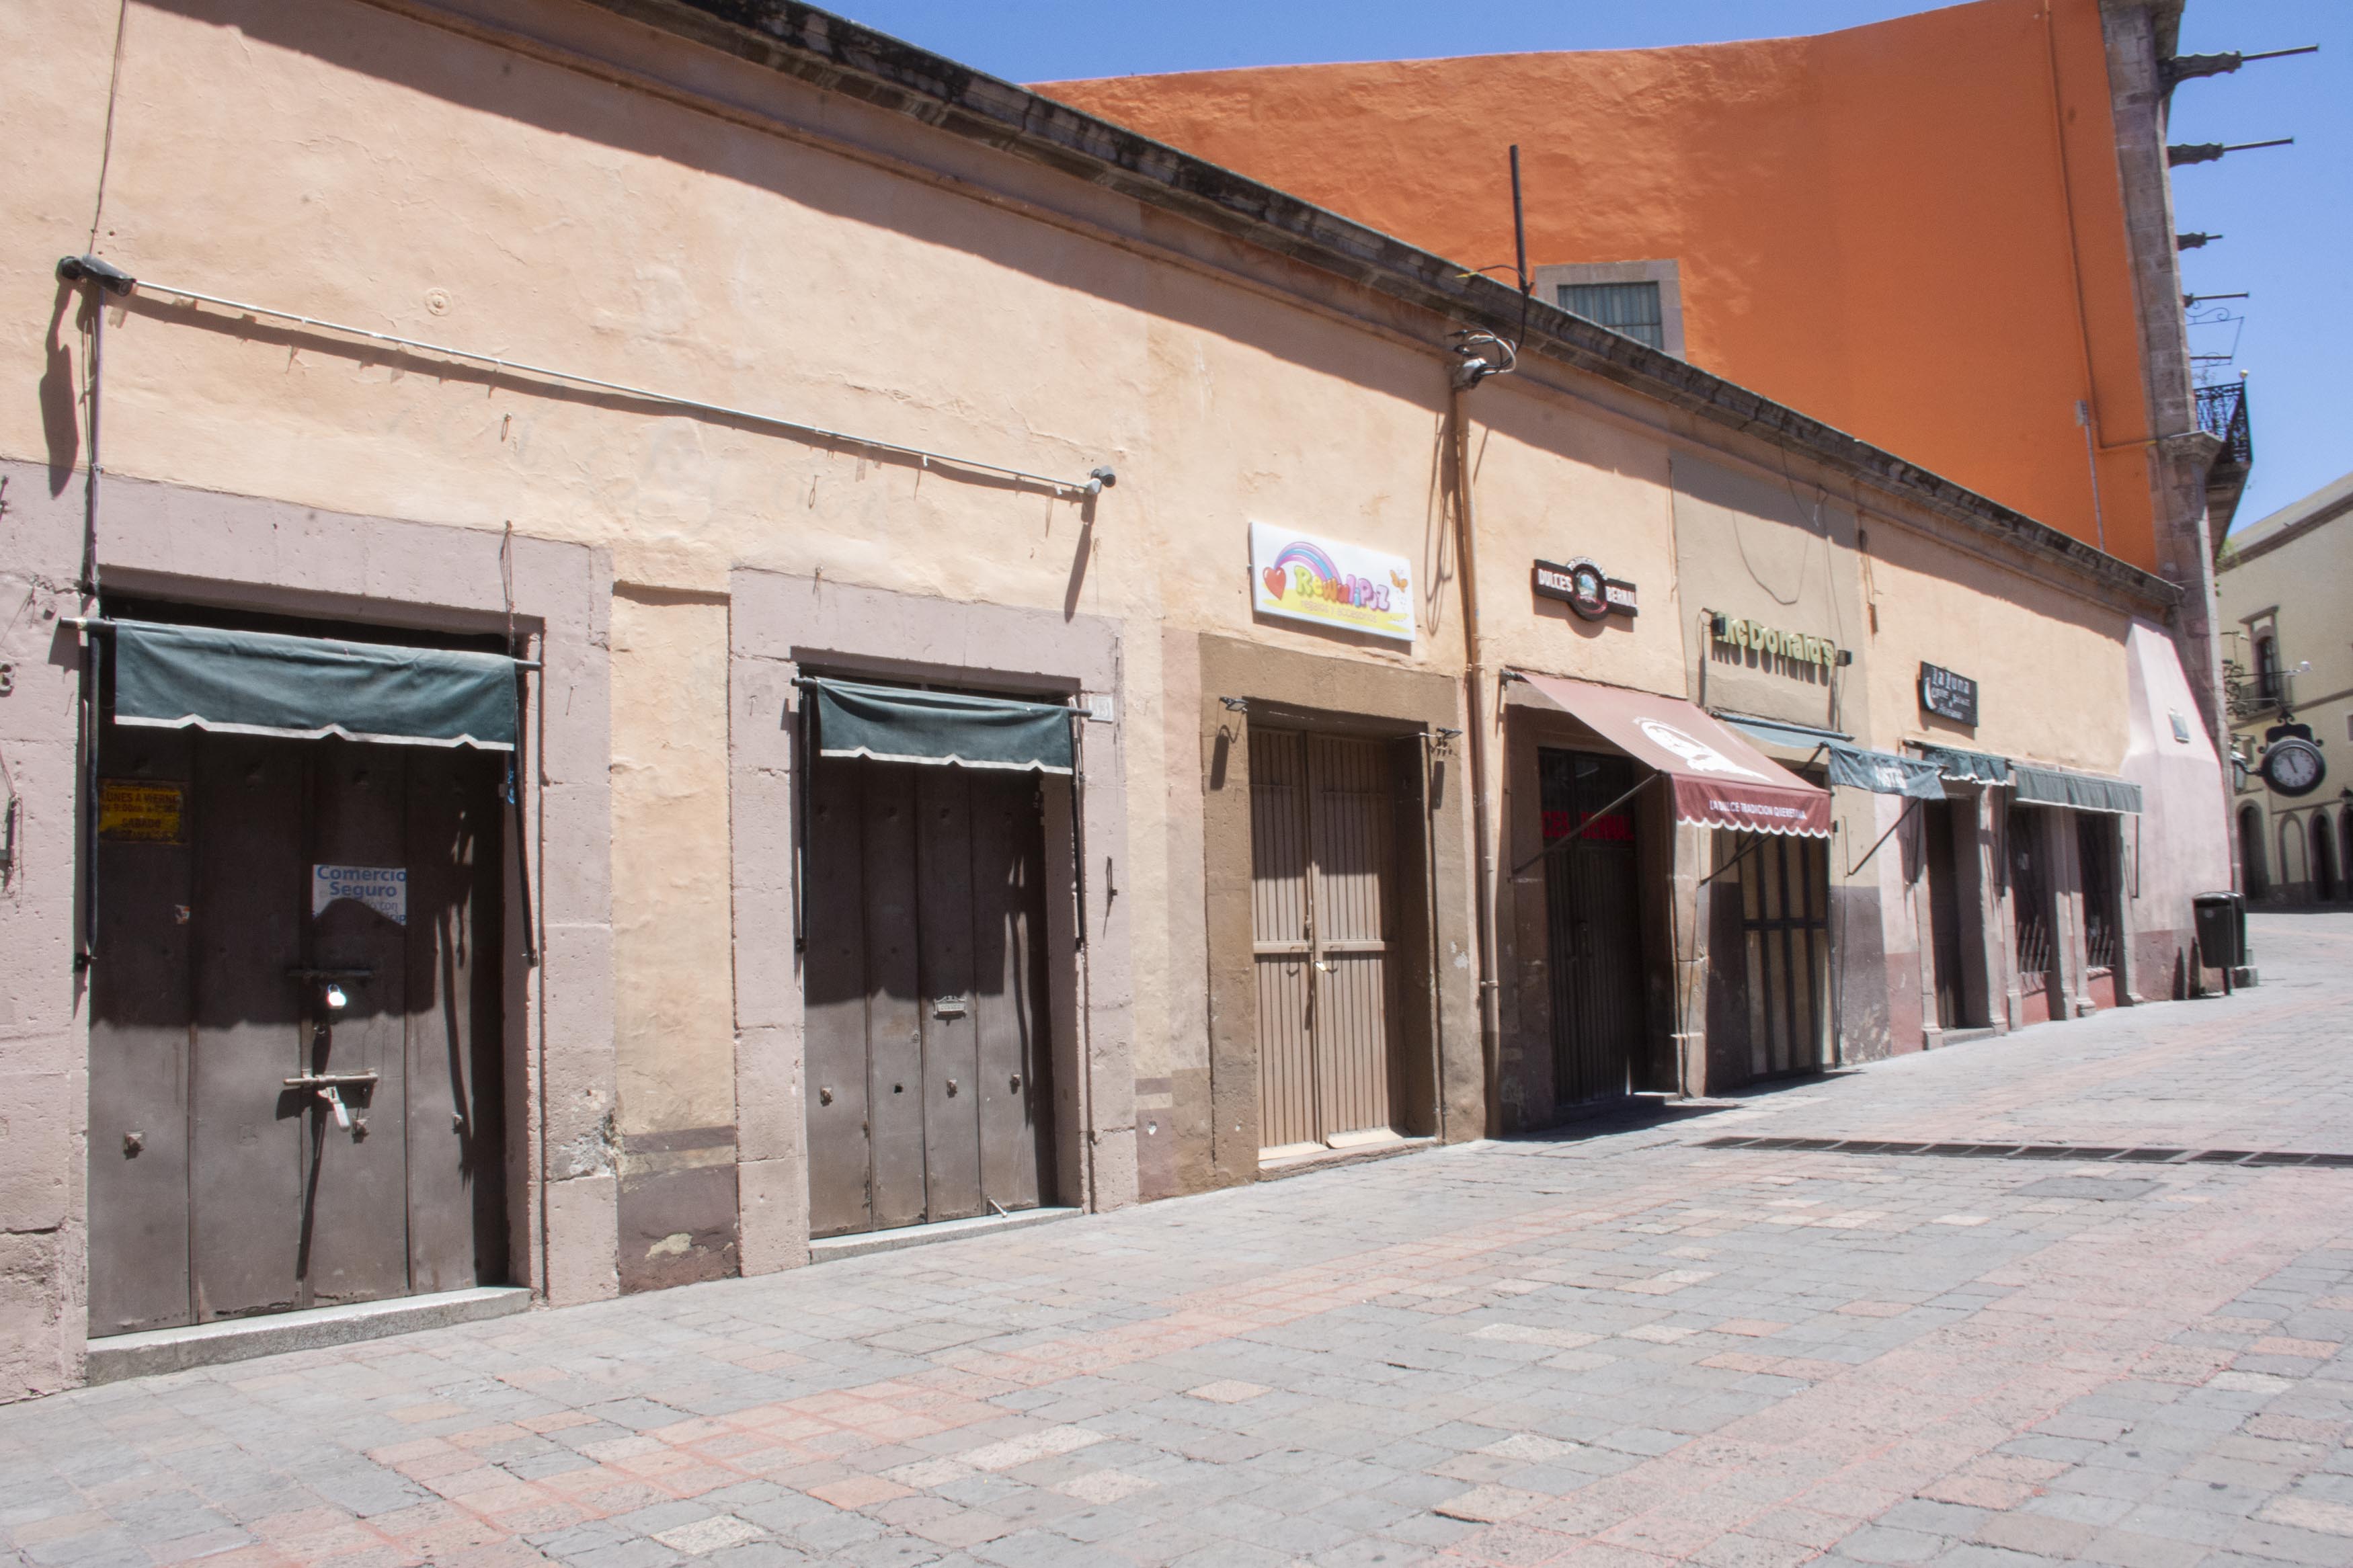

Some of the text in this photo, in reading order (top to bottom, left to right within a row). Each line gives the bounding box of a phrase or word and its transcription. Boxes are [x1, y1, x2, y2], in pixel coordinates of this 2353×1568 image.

[1538, 569, 1573, 593] DULCES
[1605, 586, 1638, 608] BERNAL
[1709, 800, 1718, 811] LA
[317, 864, 407, 882] Comercio
[329, 881, 397, 899] Seguro
